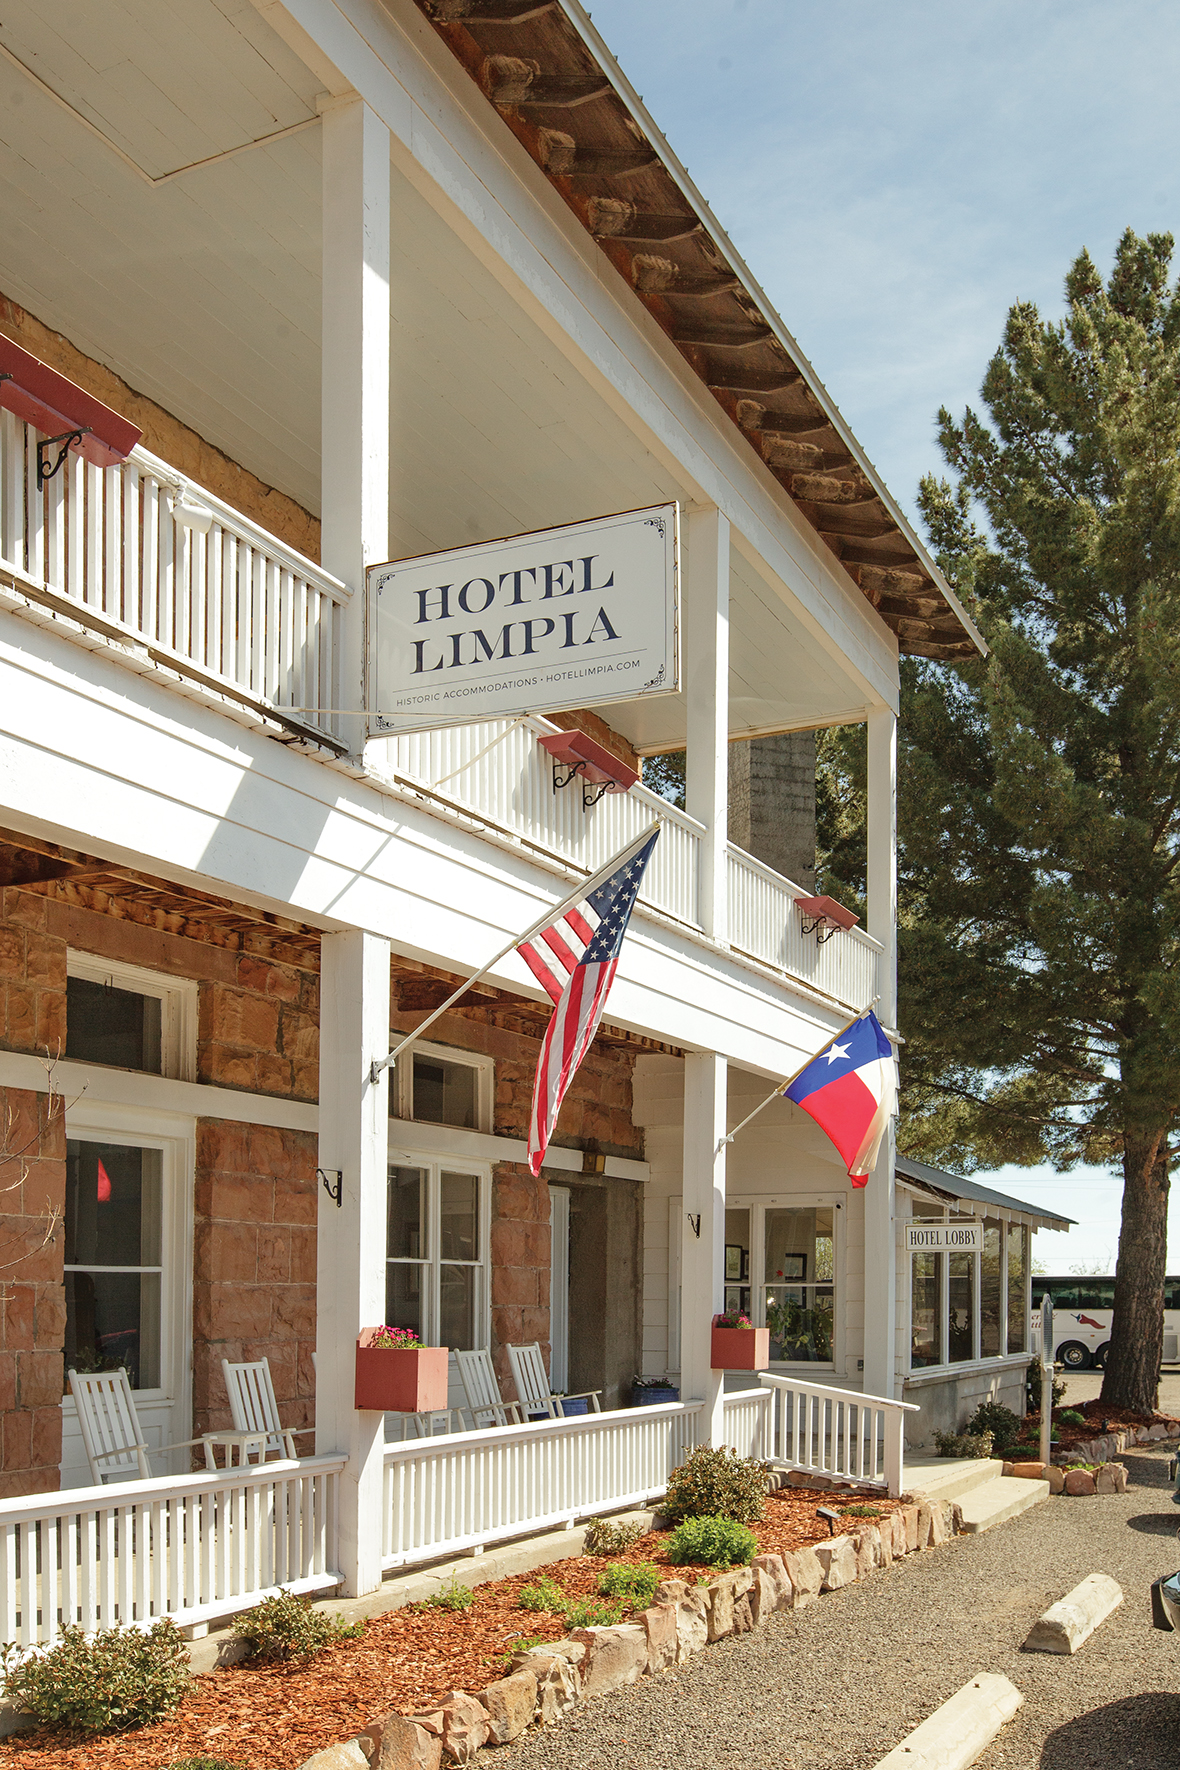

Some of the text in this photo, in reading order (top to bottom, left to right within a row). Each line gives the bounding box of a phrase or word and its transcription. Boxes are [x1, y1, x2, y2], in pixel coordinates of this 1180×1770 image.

[413, 555, 614, 625] HOTEL
[410, 606, 622, 675] LIMPIA
[396, 659, 641, 707] HISTORIC ACCOMMODATIONS HOTELLIMPIA.COM
[910, 1229, 977, 1245] HOTEL LOBBY
